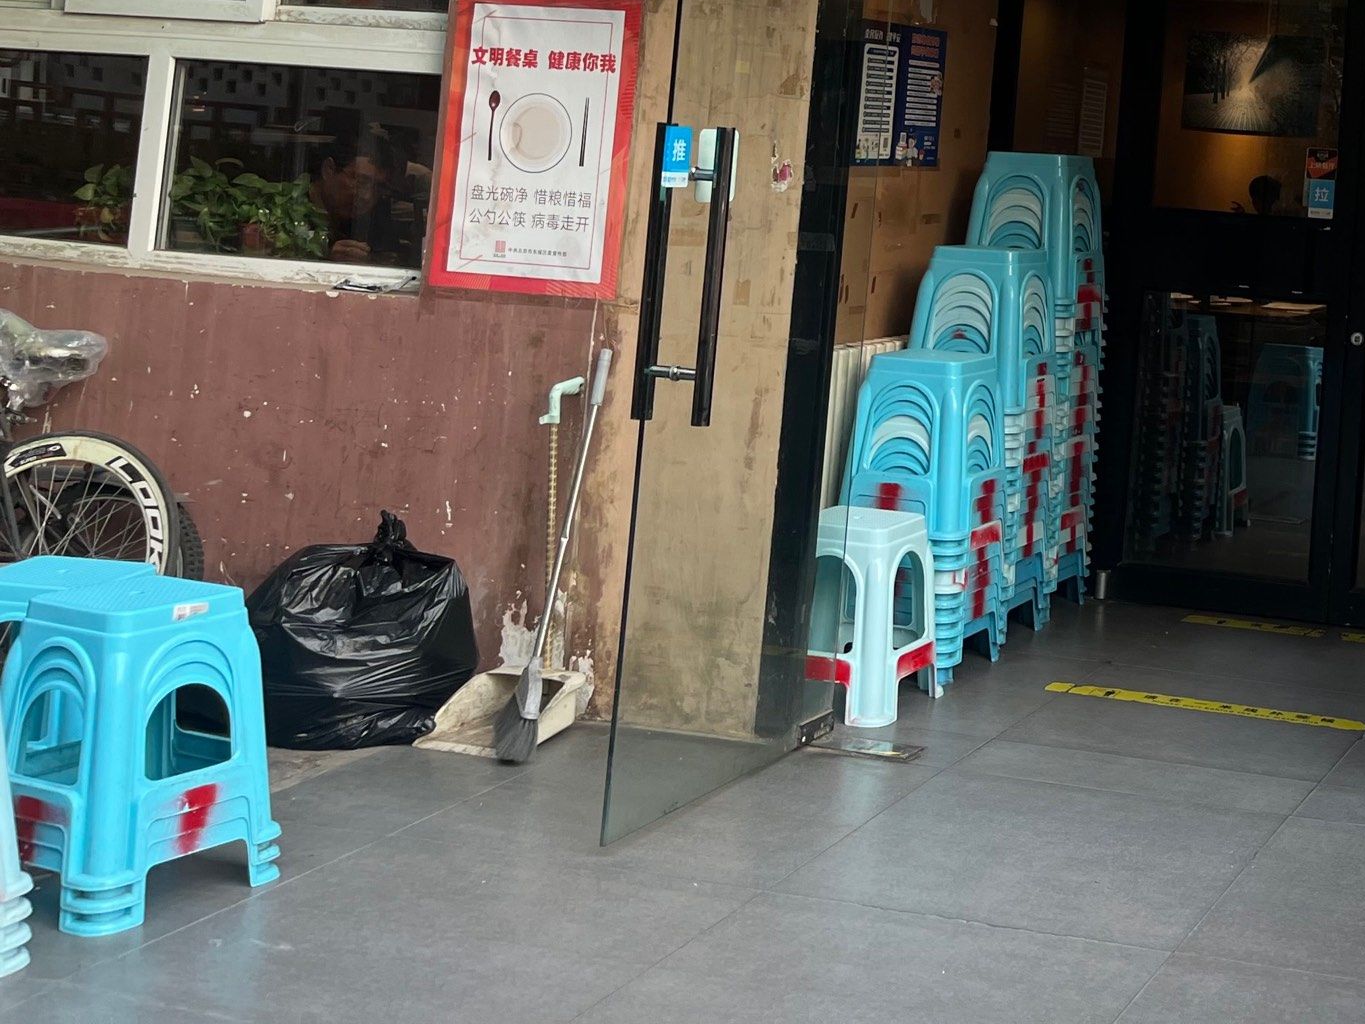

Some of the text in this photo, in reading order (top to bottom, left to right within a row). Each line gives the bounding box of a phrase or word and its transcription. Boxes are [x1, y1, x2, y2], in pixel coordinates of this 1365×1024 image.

[471, 45, 617, 74] 文明餐桌 健康你我
[671, 138, 686, 162] 推
[470, 184, 592, 209] 盘光碗净 惜粮惜福
[1314, 186, 1329, 202] 拉
[469, 207, 590, 233] 公勺公筷 病毒走开
